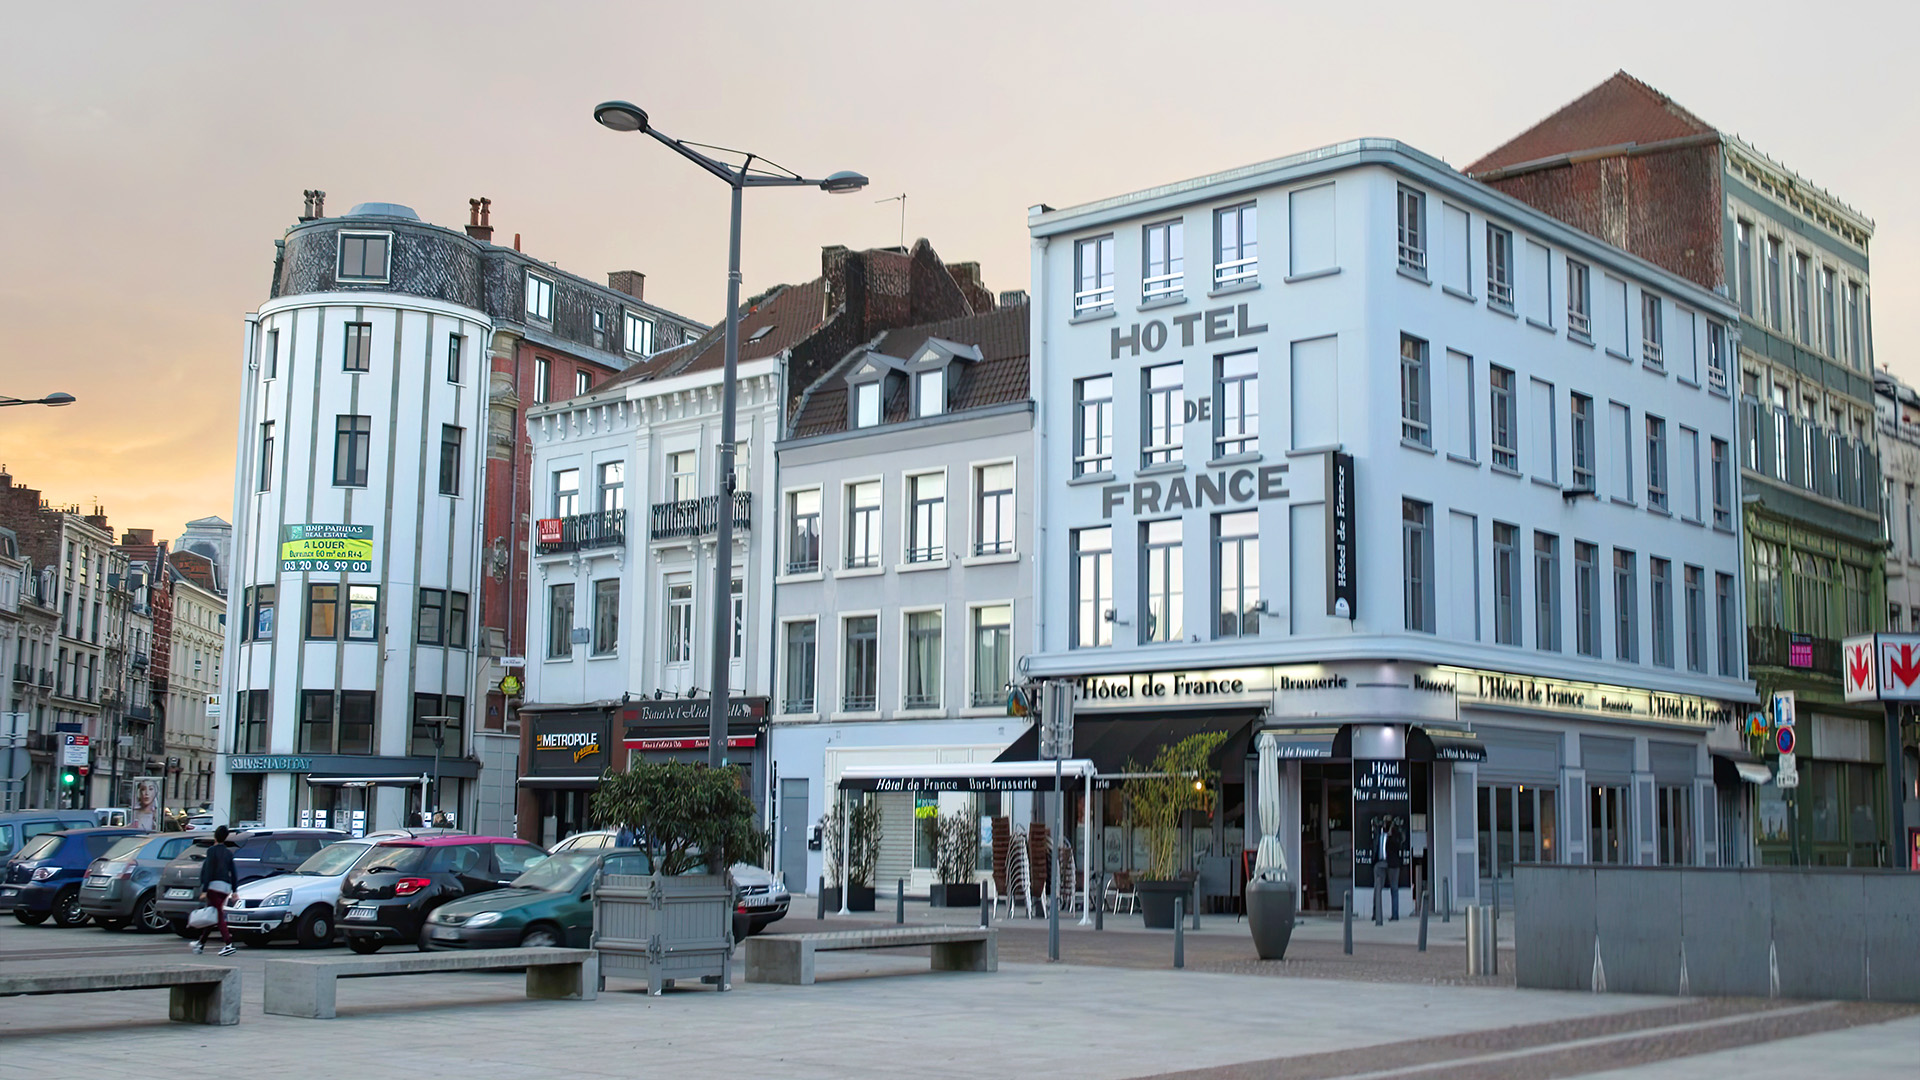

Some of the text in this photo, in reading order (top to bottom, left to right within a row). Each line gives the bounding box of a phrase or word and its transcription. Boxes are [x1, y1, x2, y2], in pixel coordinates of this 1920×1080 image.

[1110, 303, 1269, 360] HOTEL
[1183, 396, 1212, 424] DE
[1102, 463, 1290, 519] FRANCE
[324, 525, 363, 533] PARIBAS
[1336, 465, 1347, 587] Hôtel de France
[303, 541, 345, 549] A LOUER
[284, 561, 367, 572] 03 20 06 99 00
[1141, 673, 1166, 697] de
[1173, 673, 1243, 696] France
[1281, 673, 1348, 690] Brasserie
[1478, 675, 1585, 707] L'Hôtel de France
[67, 735, 75, 745] P
[542, 732, 598, 747] METROPOLE
[1371, 761, 1400, 775] Hôtel
[875, 778, 905, 791] Hôtel
[907, 777, 920, 791] de
[923, 778, 958, 791] France
[1360, 773, 1407, 788] de France
[1356, 789, 1370, 801] Bar
